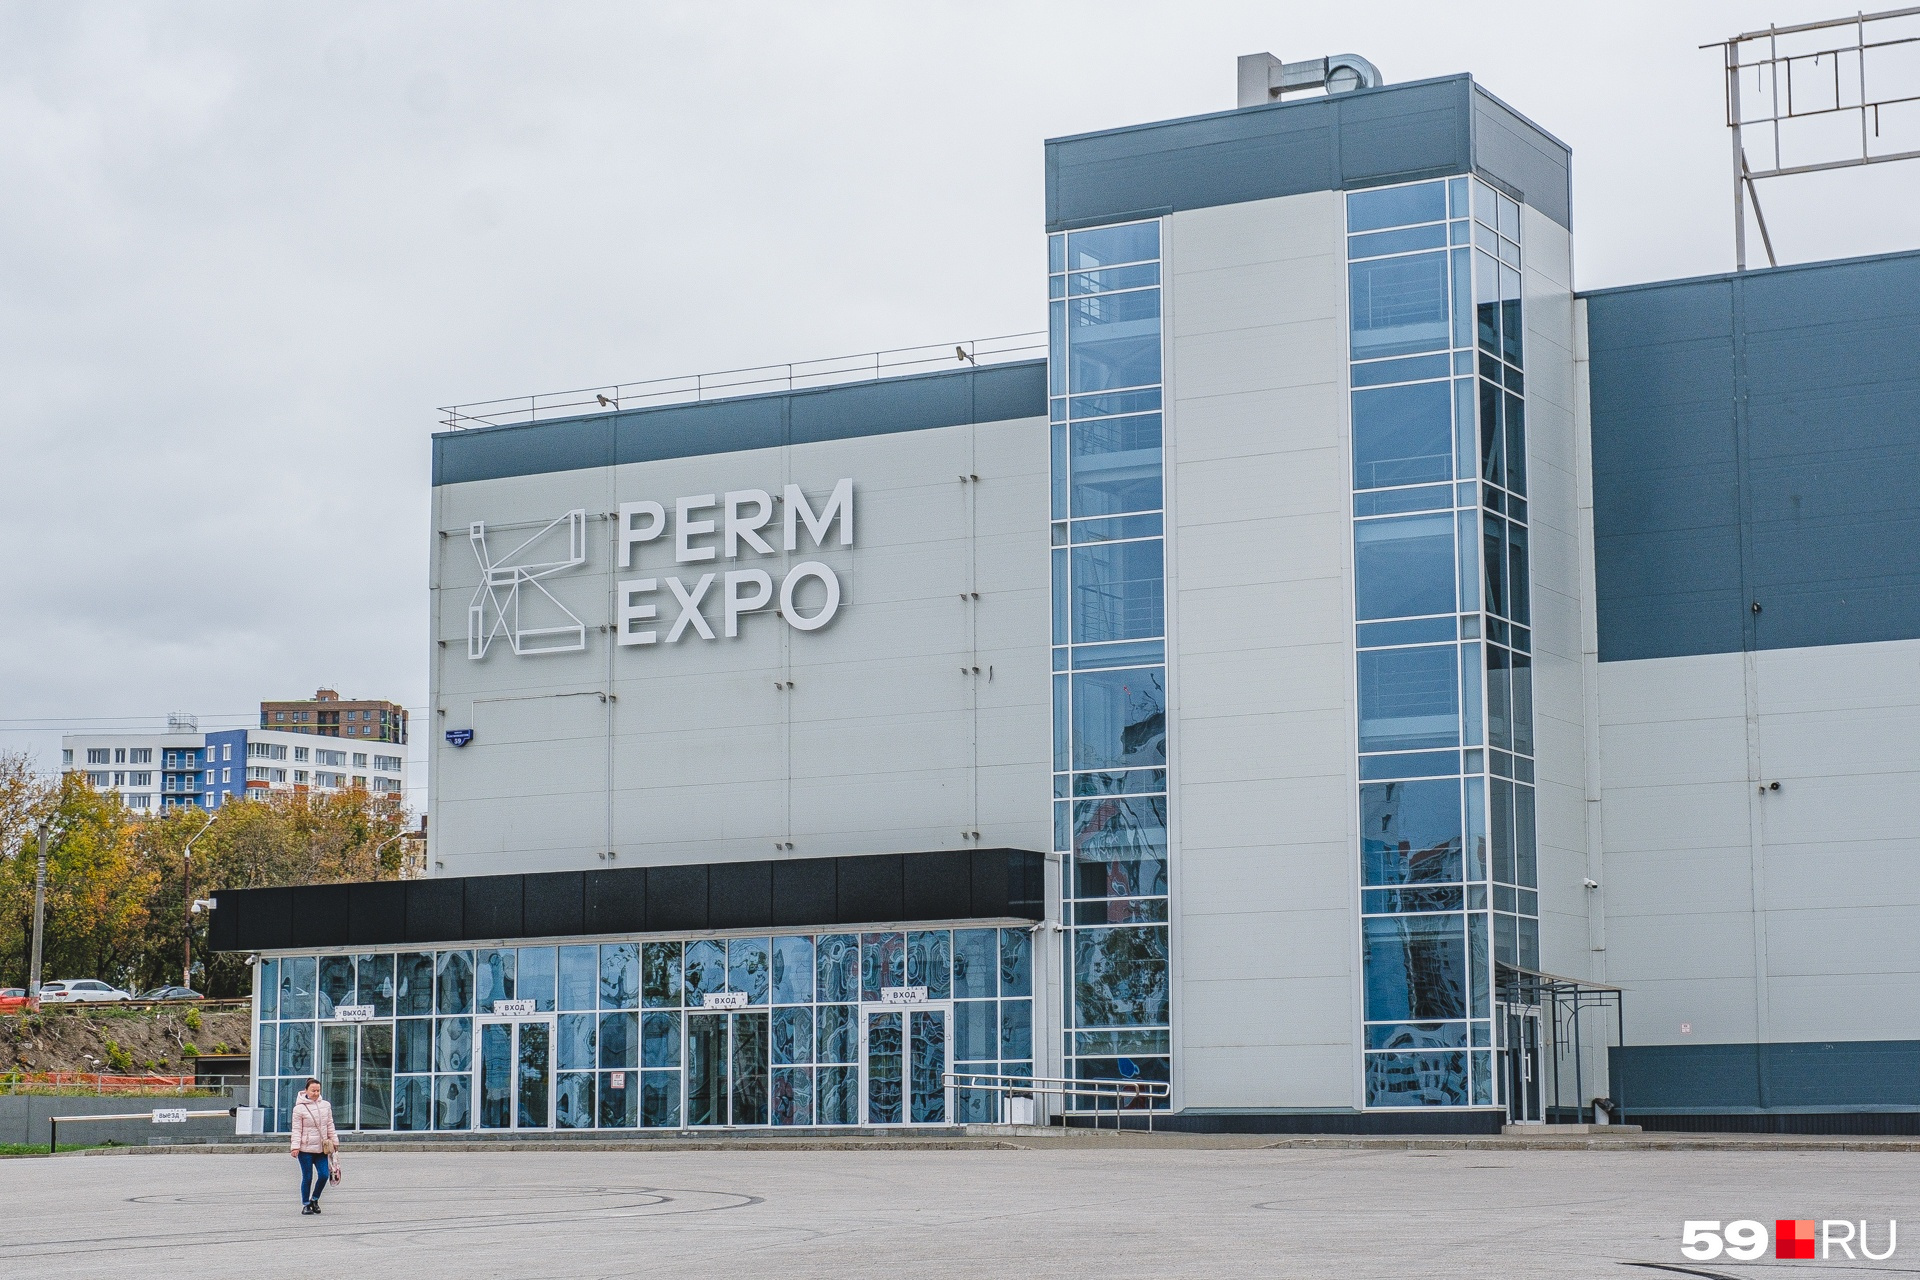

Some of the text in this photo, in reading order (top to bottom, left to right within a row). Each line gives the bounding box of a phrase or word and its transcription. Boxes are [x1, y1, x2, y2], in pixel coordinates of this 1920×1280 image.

[618, 478, 853, 567] PERM
[617, 561, 840, 646] EXPO
[893, 991, 916, 999] ВХОД
[714, 997, 737, 1005] ВХОД
[342, 1009, 367, 1017] ВЫХОД
